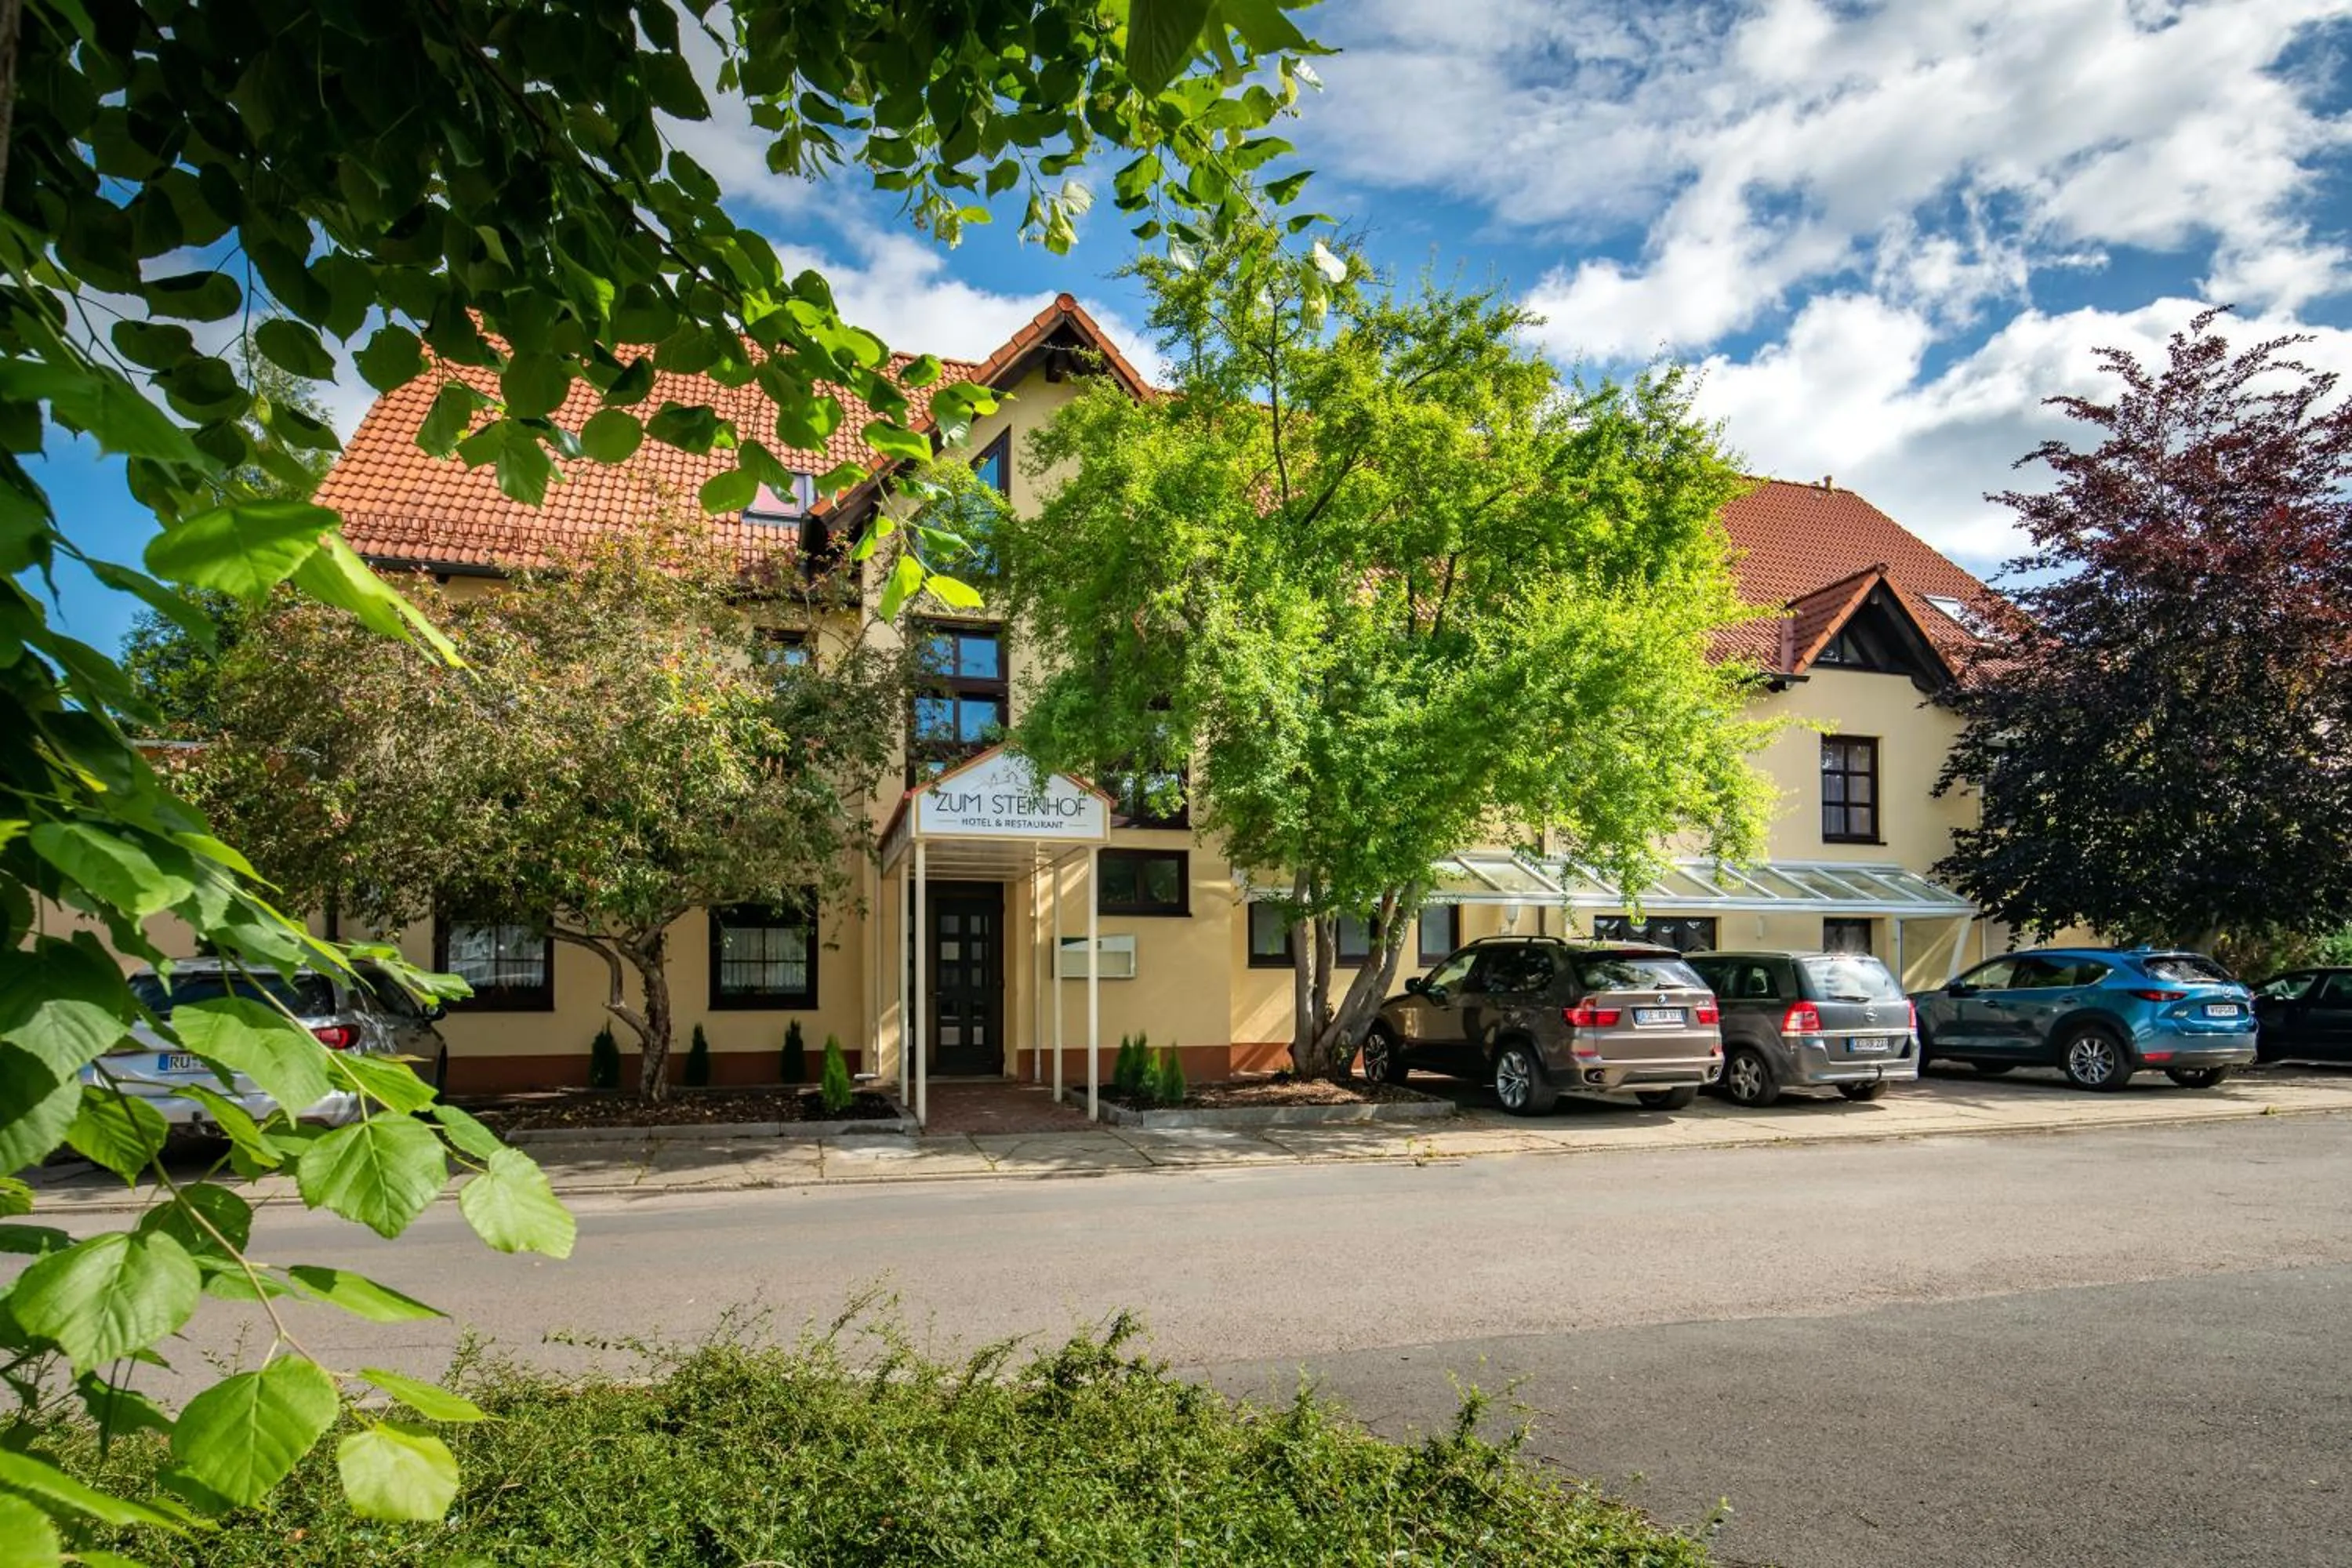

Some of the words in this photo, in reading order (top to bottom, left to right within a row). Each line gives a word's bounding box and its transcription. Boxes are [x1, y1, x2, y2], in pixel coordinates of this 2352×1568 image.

[935, 792, 981, 813] ZUM
[992, 794, 1087, 817] STEINHOF
[961, 818, 992, 827] HOTEL
[996, 818, 1002, 827] &
[1004, 819, 1065, 829] RESTAURANT
